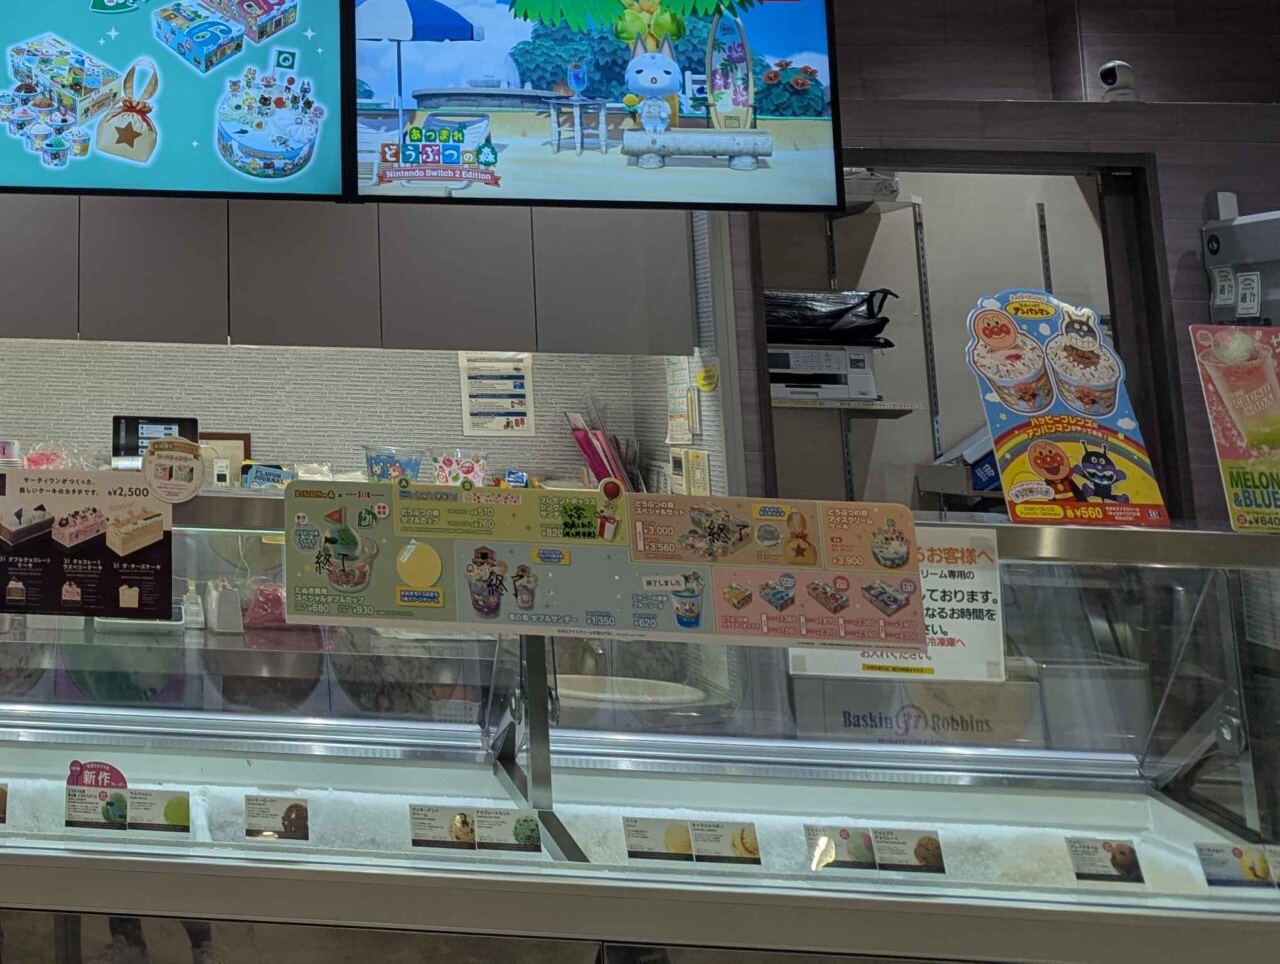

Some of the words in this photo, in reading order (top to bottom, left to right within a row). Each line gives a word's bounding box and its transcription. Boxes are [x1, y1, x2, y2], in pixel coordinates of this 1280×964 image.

[410, 128, 464, 141] あつまれ
[383, 145, 496, 163] どうぶつの森
[386, 169, 424, 178] Nintendo
[425, 169, 454, 178] Switch
[461, 170, 492, 180] Edition
[1229, 471, 1280, 490] MELON
[635, 507, 685, 516] スペシャルセット
[400, 516, 439, 524] ダブルカップ
[827, 516, 873, 524] アイスクリーム
[705, 519, 750, 544] 終了
[314, 551, 350, 575] 終了
[921, 569, 975, 580] リーム専用の
[487, 570, 524, 597] 終了
[645, 579, 682, 587] 終了しました
[295, 594, 366, 604] スペシャルダブルカップ
[308, 604, 330, 613] ¥680
[925, 607, 997, 621] なるお時間を
[633, 619, 657, 628] ¥620
[842, 710, 893, 729] Baskin
[931, 713, 992, 733] Robbins
[82, 769, 112, 786] 新作
